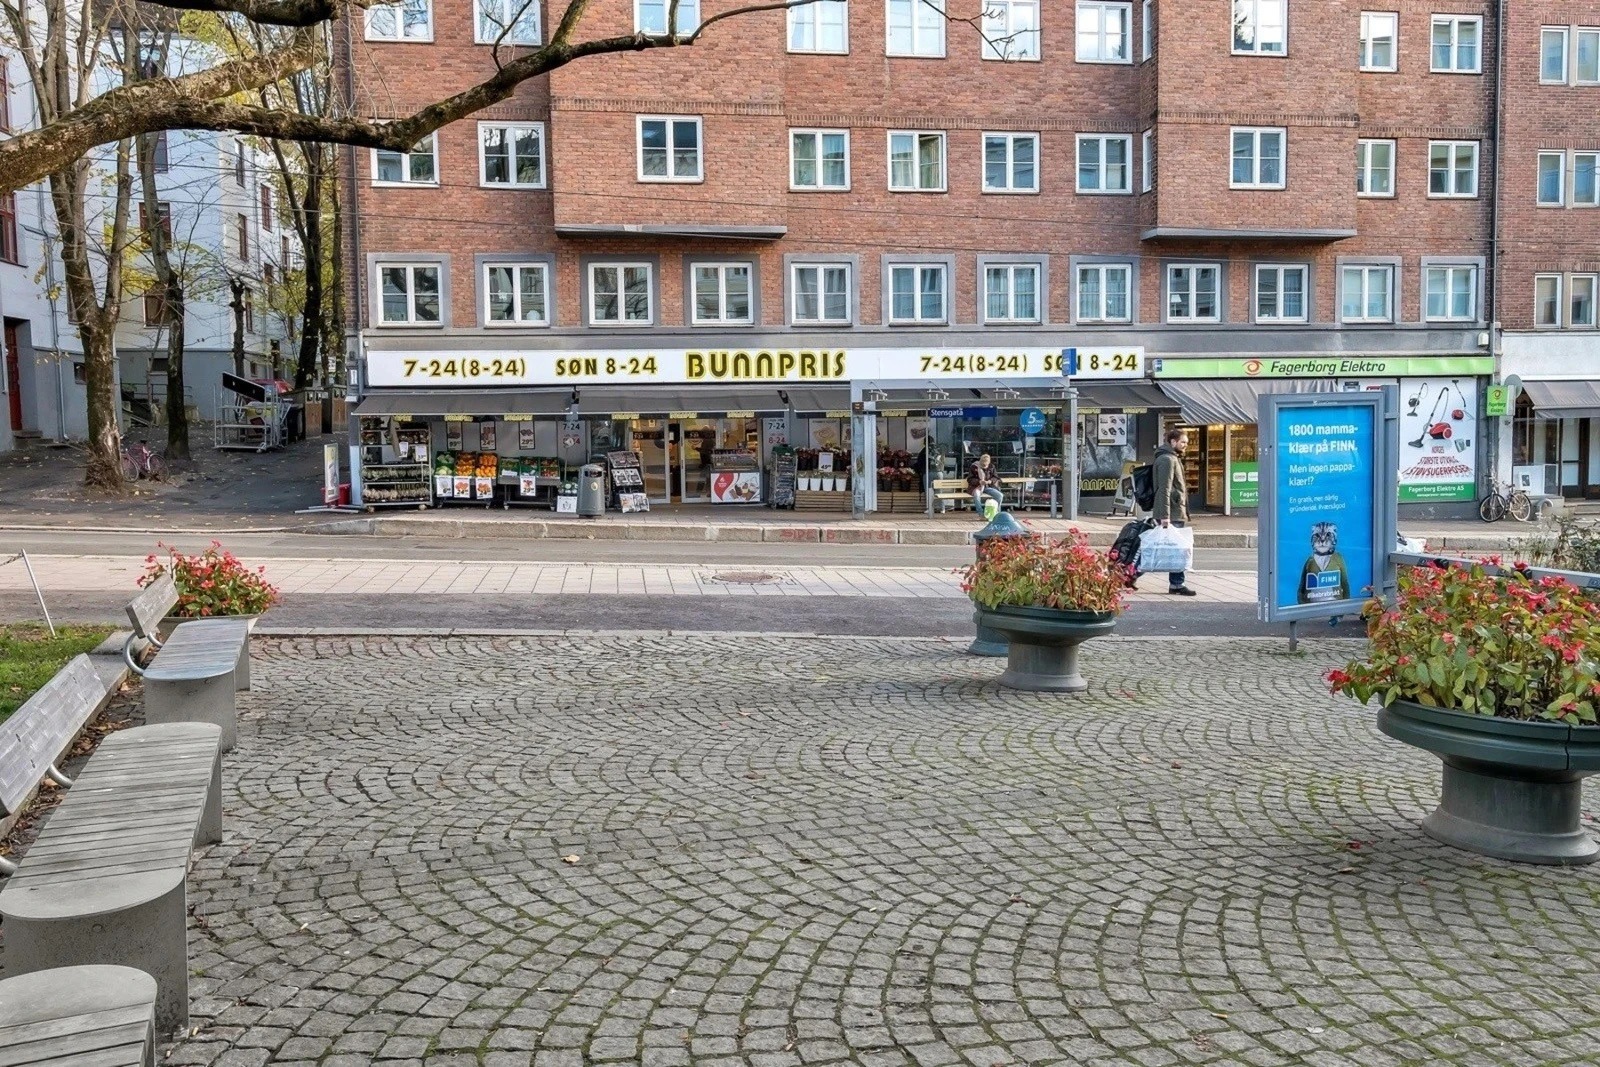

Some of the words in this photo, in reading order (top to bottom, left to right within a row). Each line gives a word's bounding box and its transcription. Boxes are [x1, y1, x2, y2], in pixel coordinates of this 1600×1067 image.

[404, 358, 526, 378] 7-24(8-24)
[556, 357, 598, 377] SØN
[605, 356, 657, 375] 8-24
[686, 351, 846, 379] BUNNPRIS
[920, 354, 1028, 373] 7-24(8-24)
[1090, 354, 1138, 371] 8-24
[1271, 360, 1337, 375] Fagerborg
[1340, 360, 1386, 372] Elektro
[1028, 412, 1036, 424] 5
[768, 422, 785, 430] 7-24
[1289, 424, 1313, 436] 1800
[1315, 425, 1358, 435] mamma-
[768, 436, 785, 444] 8-24
[1289, 441, 1315, 453] klær
[1316, 439, 1328, 455] på
[1330, 440, 1358, 452] FINN.
[1289, 465, 1307, 473] Men
[1308, 464, 1328, 474] ingen
[1330, 463, 1355, 473] pappa-
[1289, 476, 1314, 486] klær!?
